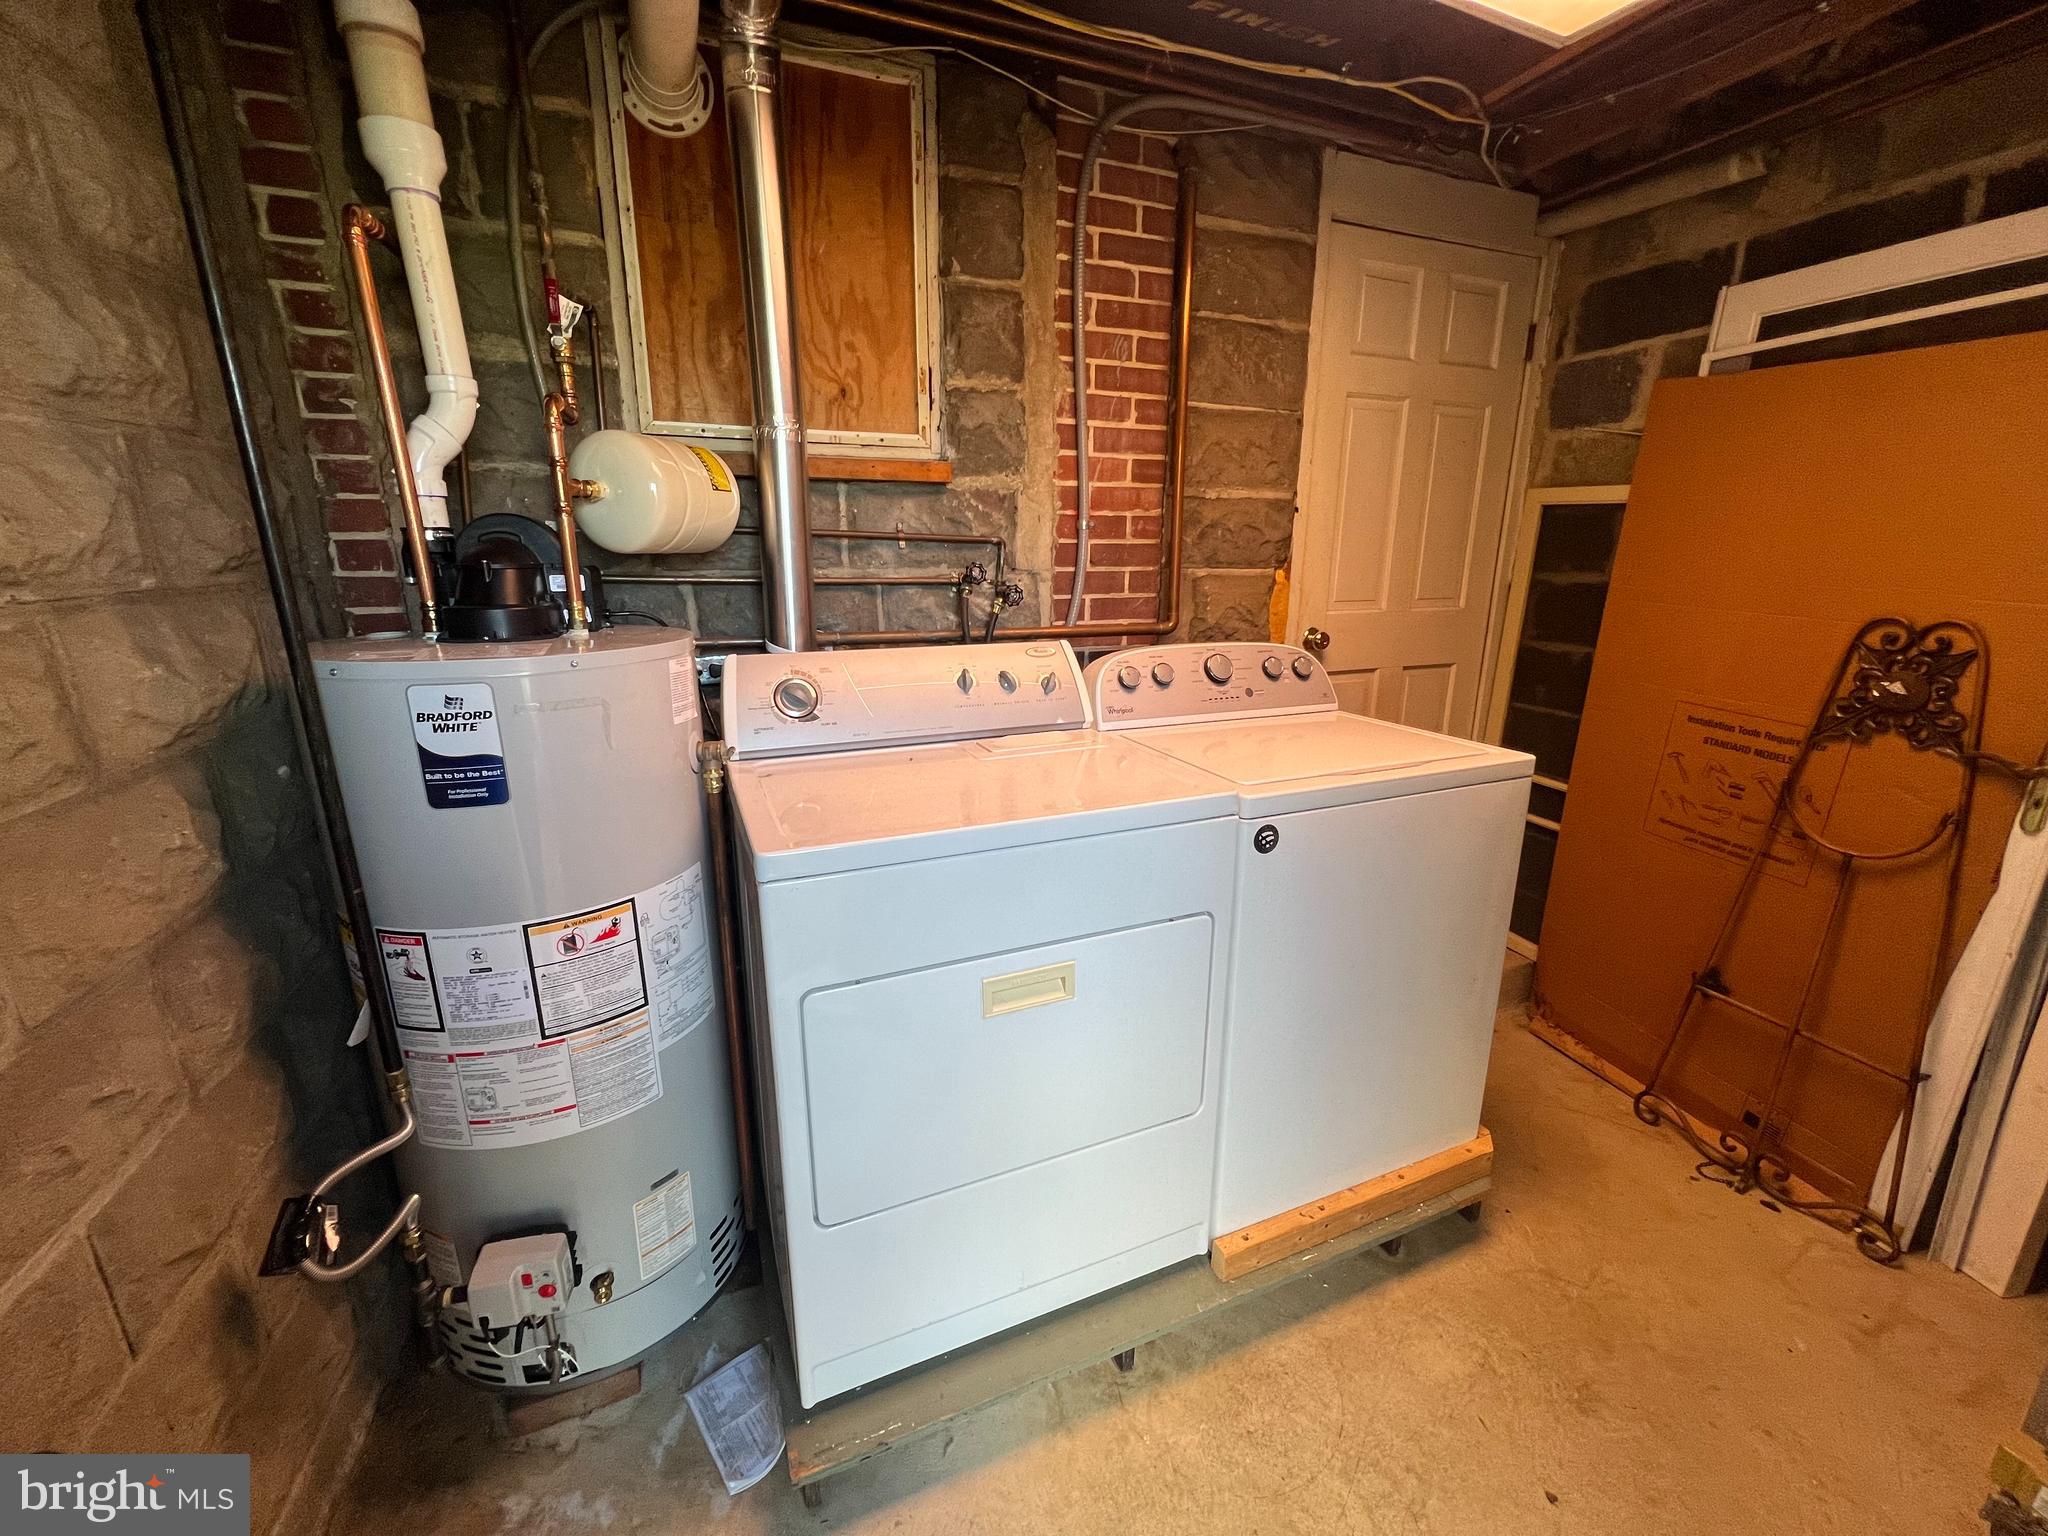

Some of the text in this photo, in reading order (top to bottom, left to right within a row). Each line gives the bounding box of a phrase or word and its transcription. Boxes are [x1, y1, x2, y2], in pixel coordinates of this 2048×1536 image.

[416, 710, 493, 723] BRADFORD
[432, 722, 478, 733] WHITE
[1687, 714, 1736, 733] Installation
[1738, 725, 1762, 738] Tools
[1703, 736, 1795, 765] STANDARD MODELS
[571, 914, 603, 927] WARNING
[389, 936, 416, 945] DANGER
